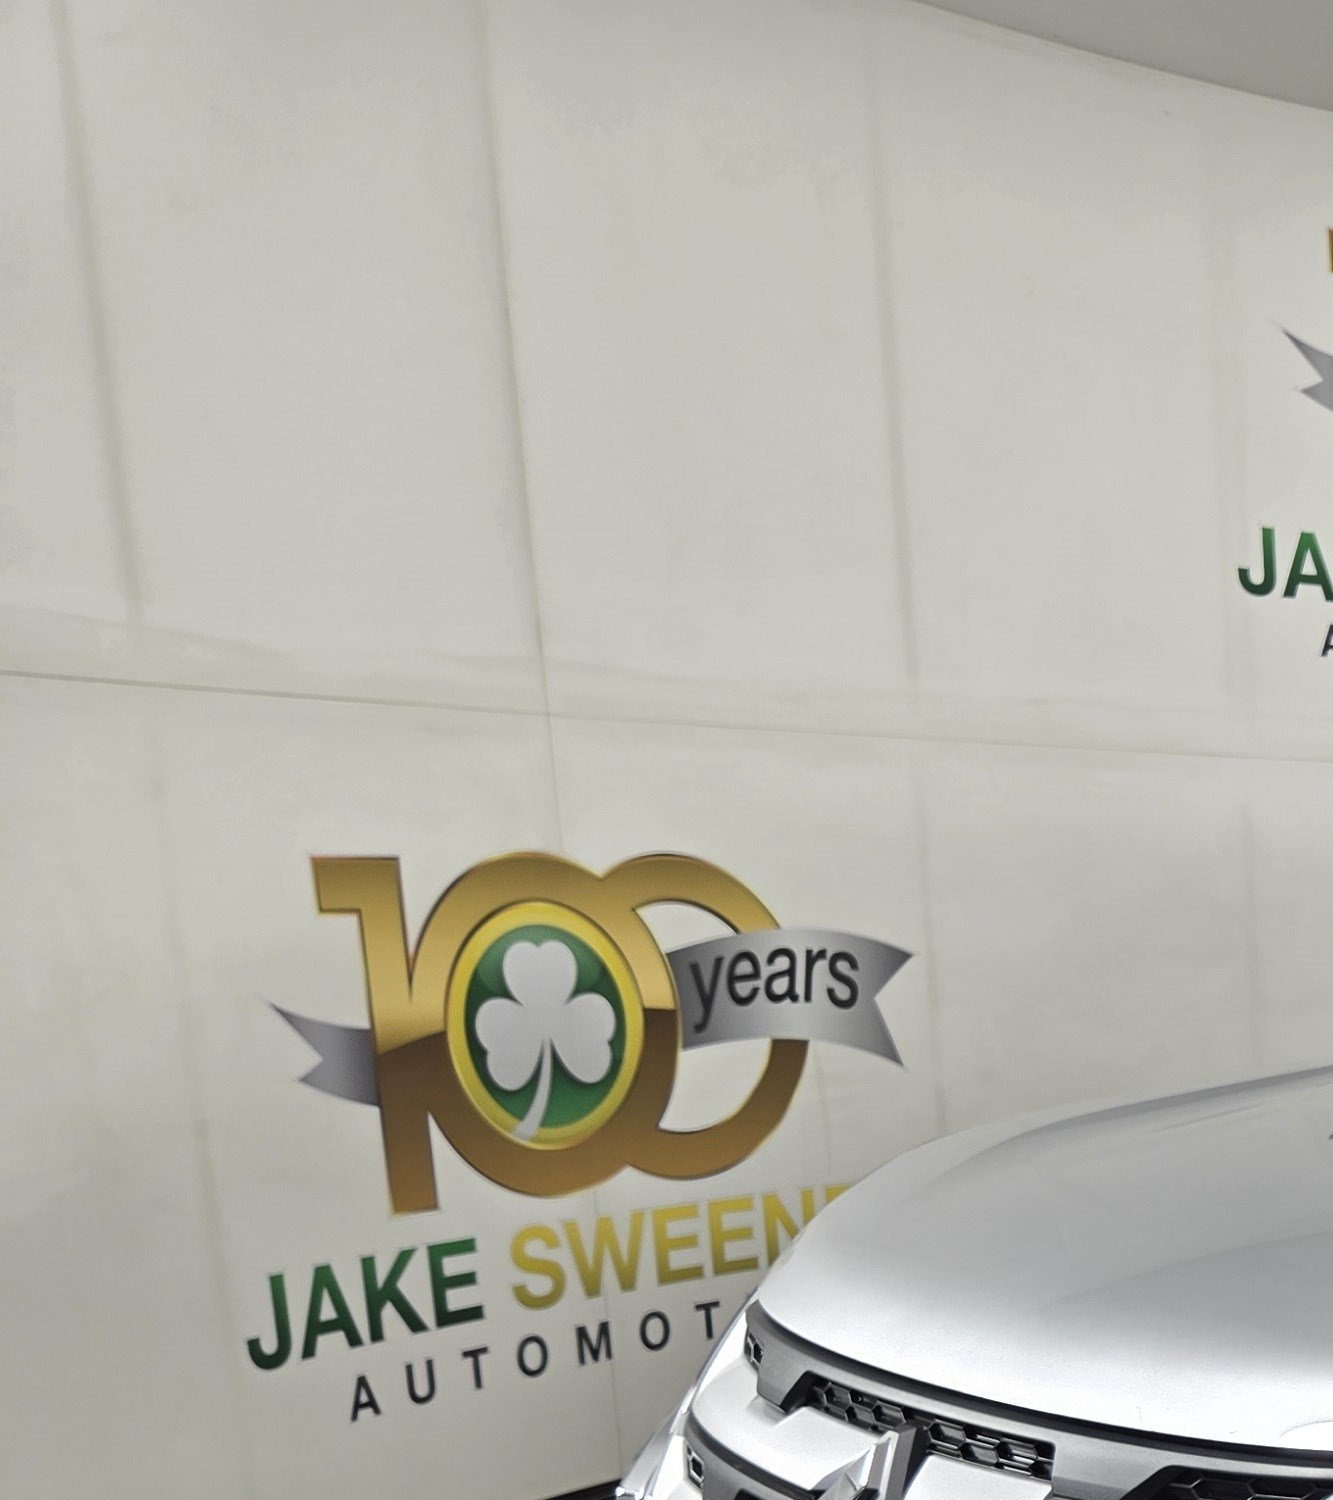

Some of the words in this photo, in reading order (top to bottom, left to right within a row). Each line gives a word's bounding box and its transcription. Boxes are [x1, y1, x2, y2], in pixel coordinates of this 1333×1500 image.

[310, 851, 810, 1217] 100
[690, 944, 860, 1033] years
[246, 1236, 485, 1371] JAKE
[510, 1183, 850, 1311] SWEEN
[350, 1300, 721, 1422] AUTOMOT
